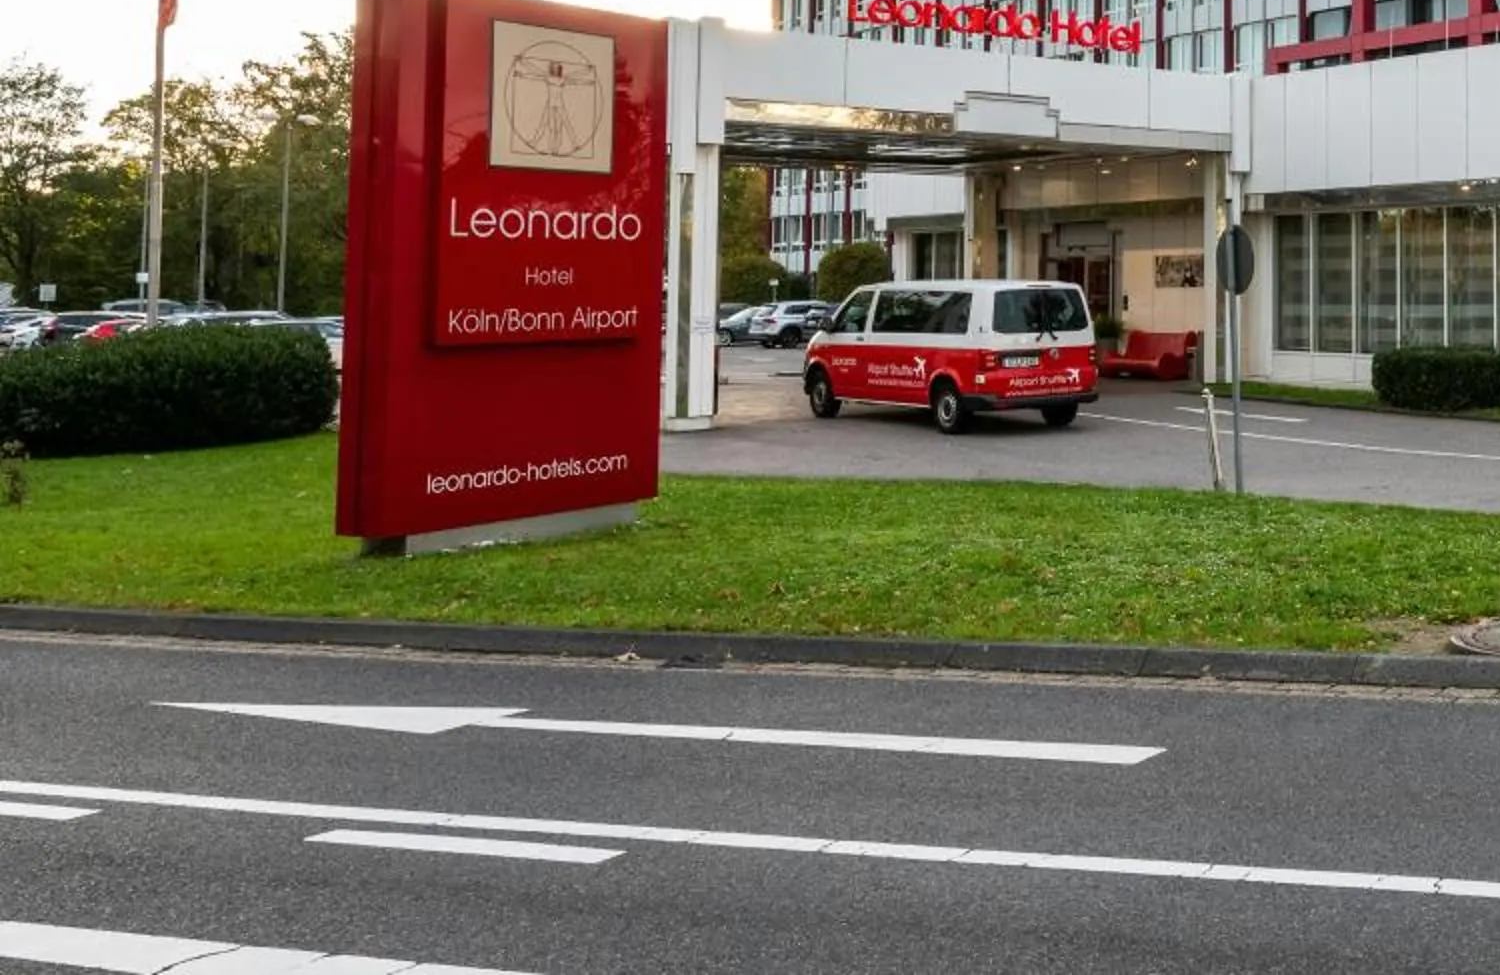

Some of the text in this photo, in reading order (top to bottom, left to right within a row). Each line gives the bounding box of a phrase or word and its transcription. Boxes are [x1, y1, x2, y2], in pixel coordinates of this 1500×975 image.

[1050, 9, 1142, 54] Hotel
[450, 197, 642, 241] Leonardo
[525, 266, 574, 286] Hotel
[448, 305, 639, 334] Köln/Bonn Airport
[1009, 375, 1039, 387] Airport
[426, 453, 629, 495] leonardo-hotels.com
